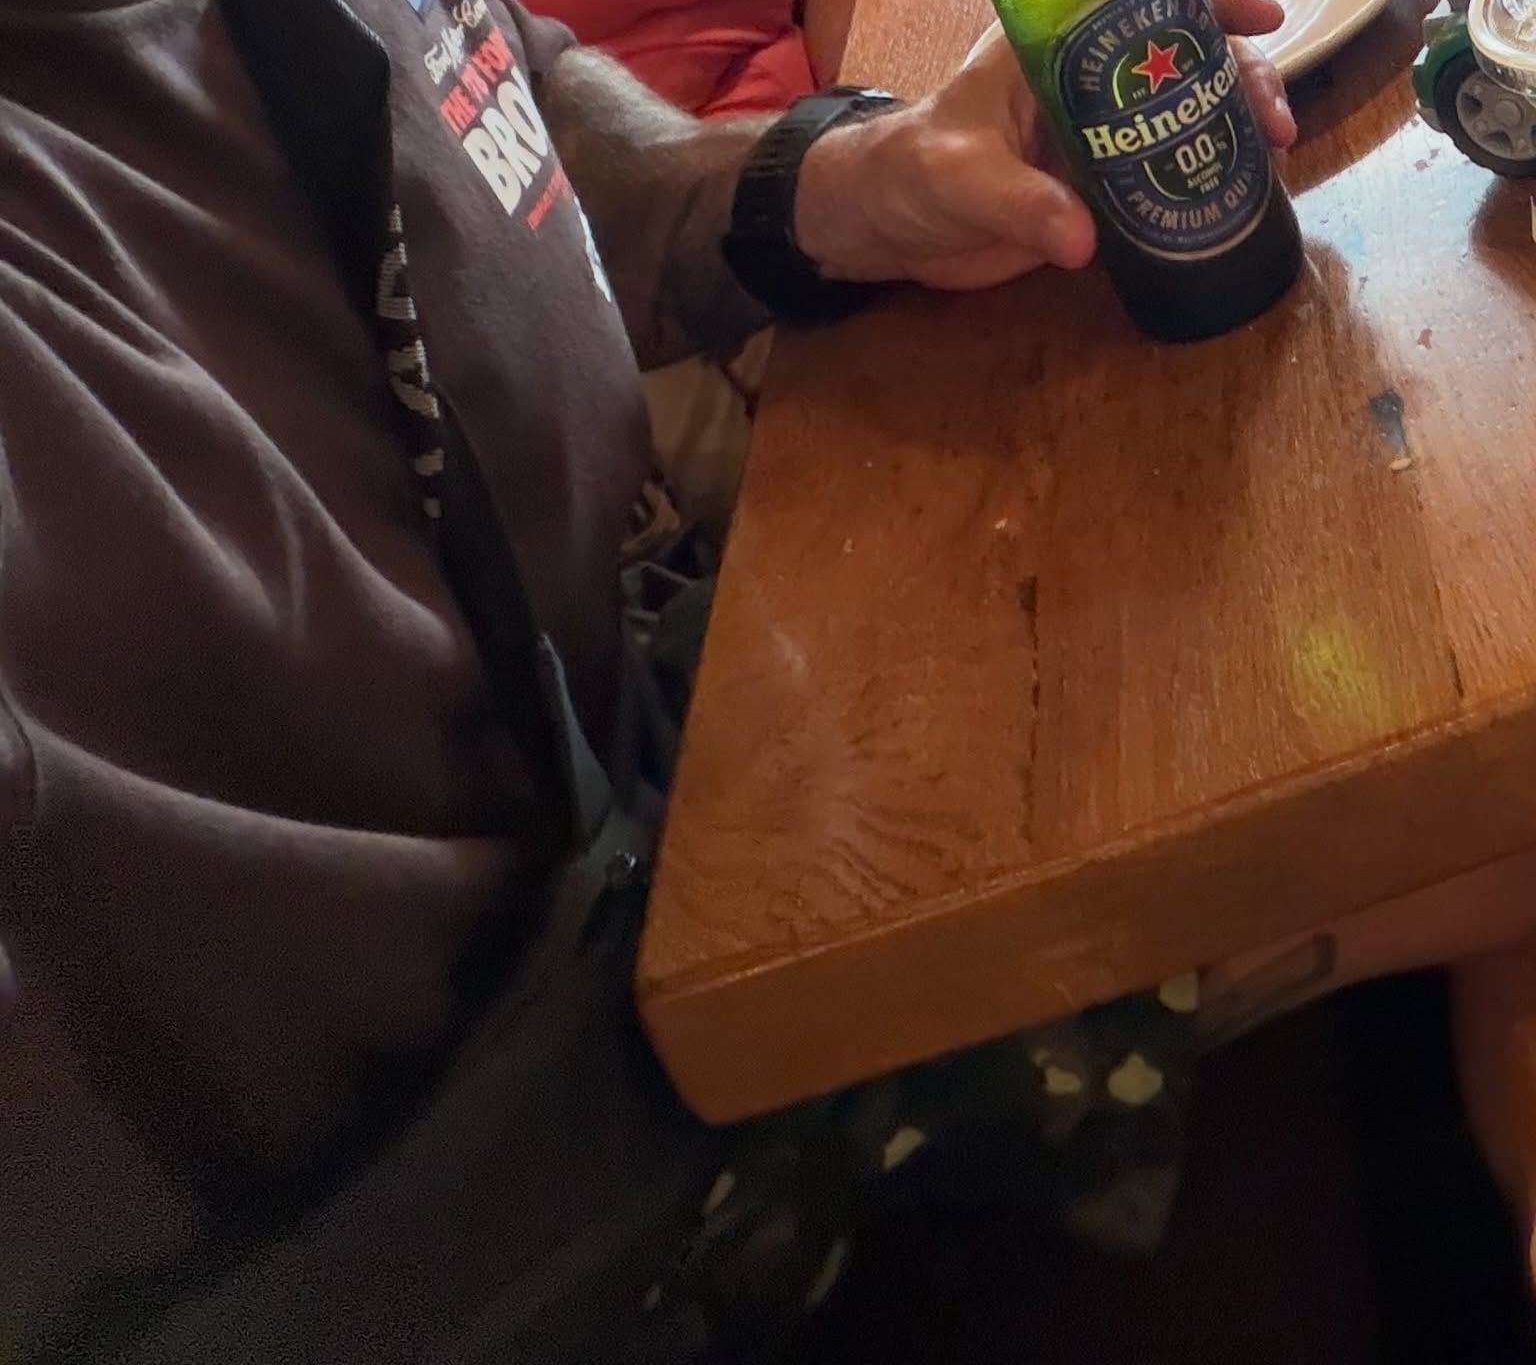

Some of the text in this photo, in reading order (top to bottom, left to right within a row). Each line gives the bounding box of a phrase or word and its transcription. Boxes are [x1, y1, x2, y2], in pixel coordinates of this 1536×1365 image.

[1081, 52, 1240, 160] Heineken
[1174, 133, 1216, 175] 0.0
[1126, 189, 1221, 230] PREMIUM
